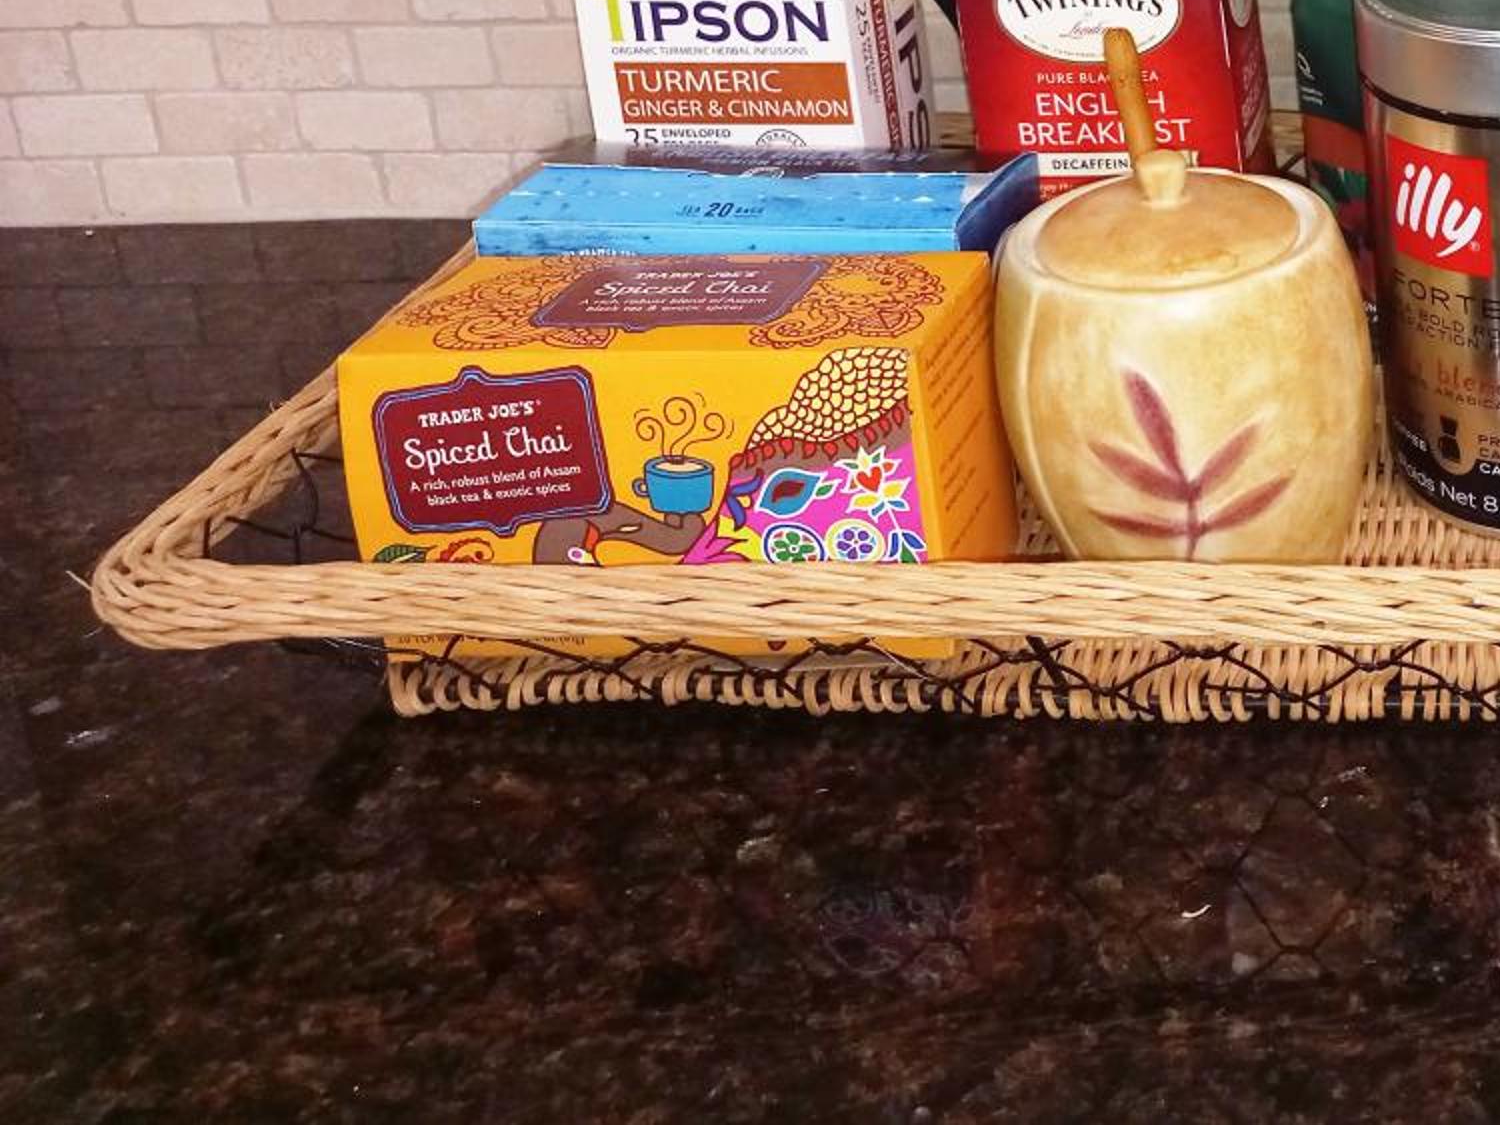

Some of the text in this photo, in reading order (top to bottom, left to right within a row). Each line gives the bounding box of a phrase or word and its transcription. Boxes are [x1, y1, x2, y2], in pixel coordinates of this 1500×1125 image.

[611, 46, 657, 55] ORGANIC
[712, 46, 749, 55] HERBAL
[753, 46, 808, 55] INFUSIONS
[621, 69, 783, 93] TURMERIC
[1037, 70, 1159, 84] PURE BLA EA
[624, 100, 849, 119] GINGER & CINNAMON
[1035, 90, 1166, 117] ENGLH
[661, 128, 732, 139] ENVELOPED
[1018, 118, 1191, 146] BREAKST
[704, 203, 735, 217] 20
[1396, 161, 1483, 257] illy
[635, 272, 704, 280] TRADER
[595, 280, 774, 297] Spiced Chai
[418, 400, 536, 428] TRADER JOE'S
[404, 425, 573, 475] Spiced Chai
[410, 465, 581, 492] A rich, robust blend of Assam
[427, 483, 571, 506] black tea & exotic spices
[1440, 482, 1476, 509] Net
